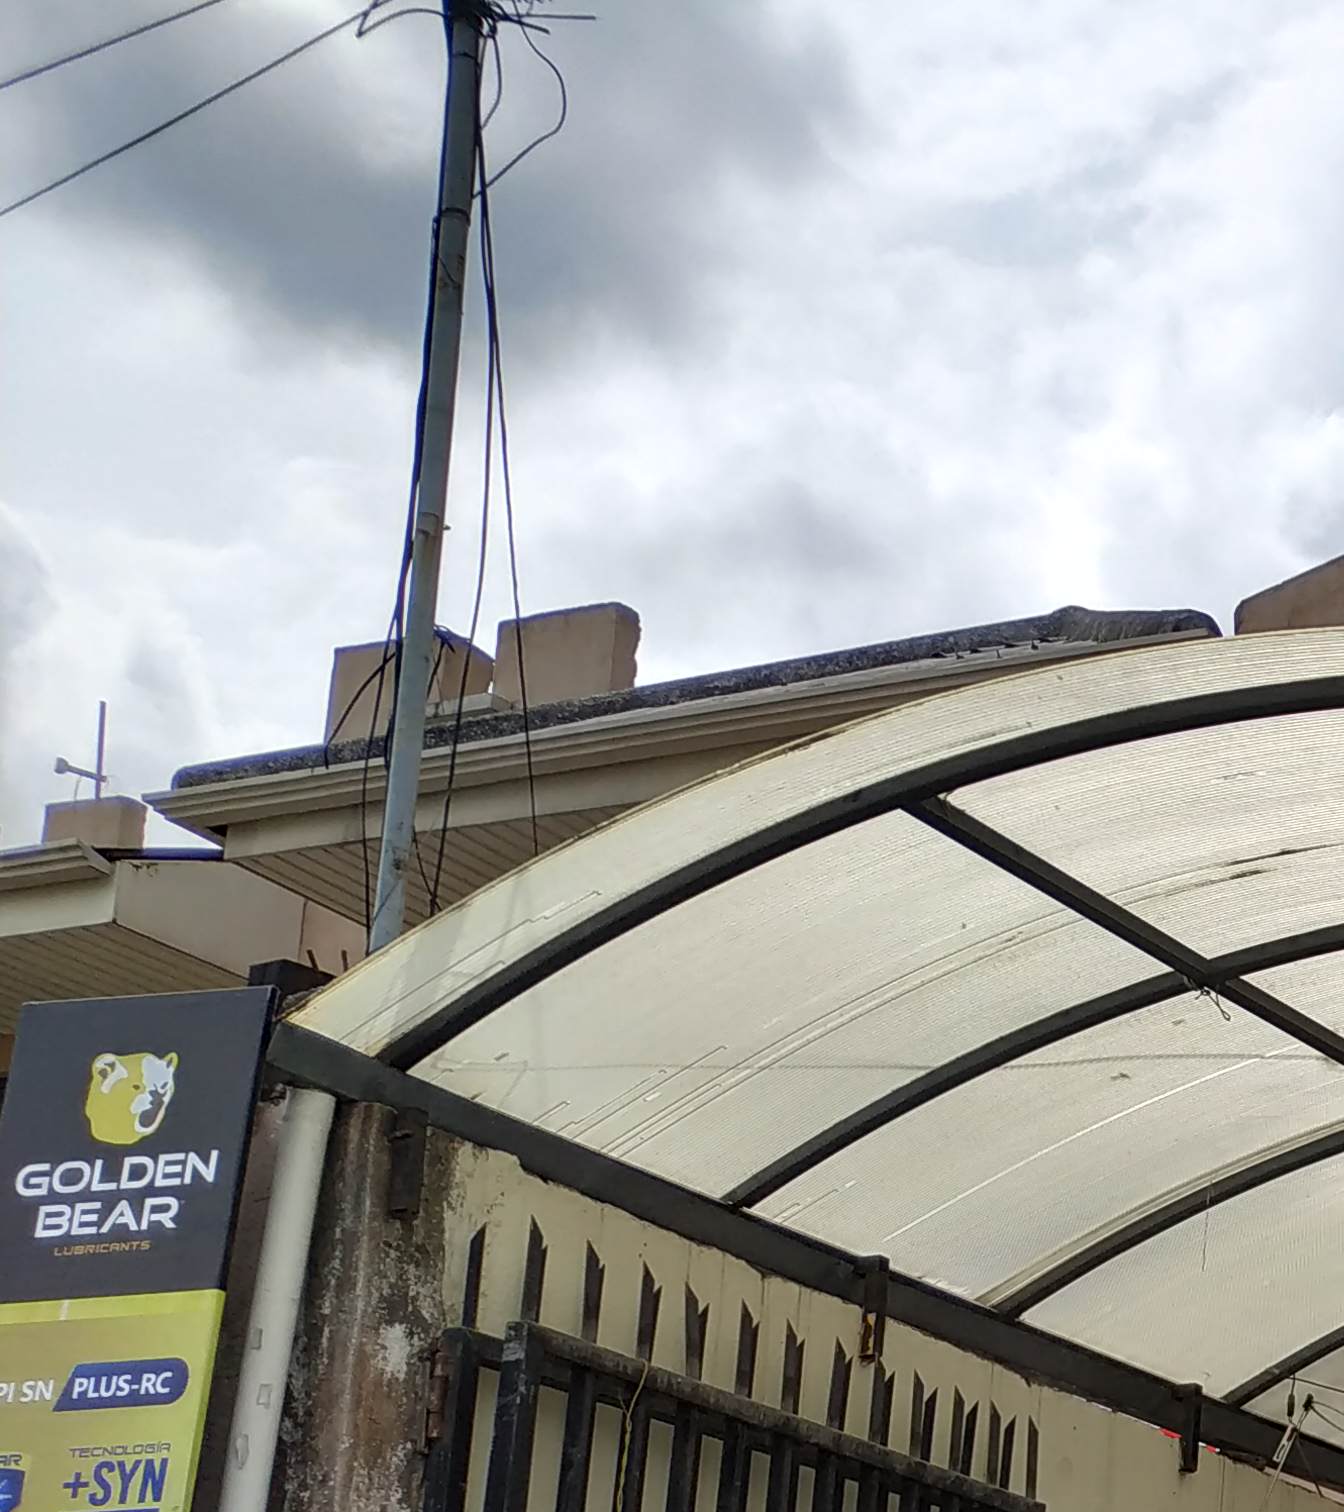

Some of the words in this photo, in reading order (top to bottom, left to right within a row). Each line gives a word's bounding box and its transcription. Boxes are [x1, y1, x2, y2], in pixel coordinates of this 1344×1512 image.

[15, 1149, 219, 1197] GOLDEN
[34, 1196, 179, 1238] BEAR
[53, 1239, 152, 1257] LUBRICANTS
[20, 1379, 54, 1403] SN
[71, 1371, 173, 1400] PLUS-RC
[63, 1457, 169, 1507] +SYN
